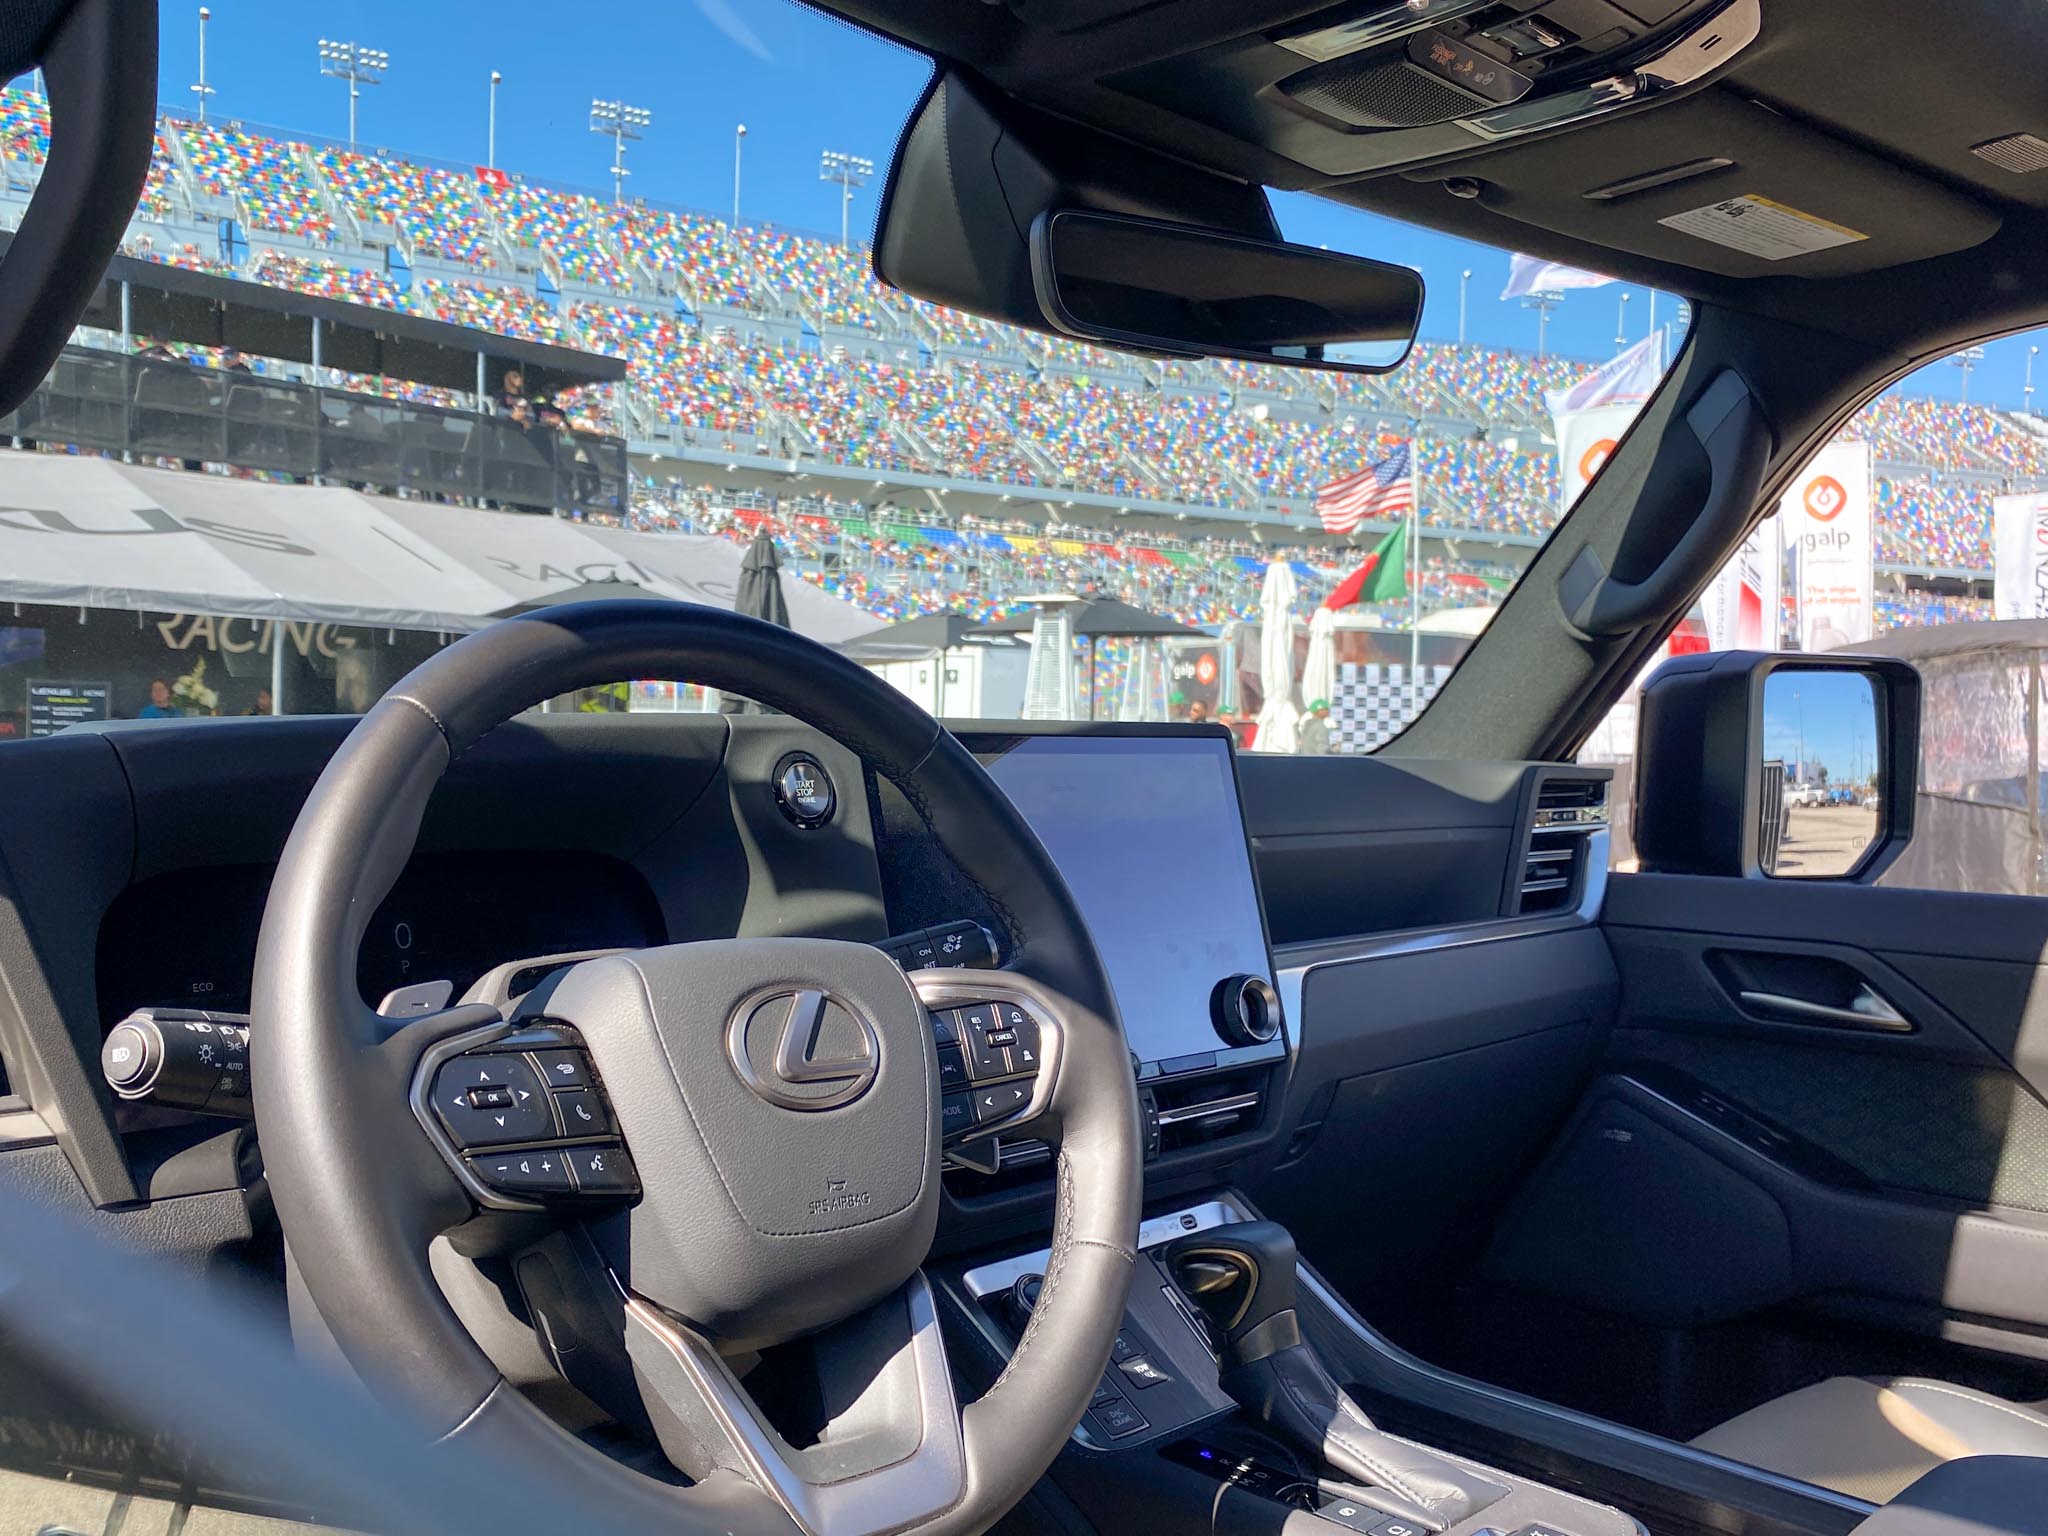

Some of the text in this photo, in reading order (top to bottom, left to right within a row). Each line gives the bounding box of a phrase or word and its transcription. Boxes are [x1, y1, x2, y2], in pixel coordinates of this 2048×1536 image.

[1805, 527, 1850, 552] galp
[157, 613, 356, 658] RACING
[1173, 662, 1195, 680] galp
[795, 780, 815, 789] START
[796, 788, 814, 797] STOP
[394, 922, 412, 949] 0
[919, 948, 932, 957] ON
[402, 959, 411, 974] P
[923, 960, 937, 969] INT
[192, 982, 214, 993] ECO
[970, 1016, 981, 1024] RES
[995, 1033, 1013, 1042] CANCEL
[226, 1062, 243, 1071] AUTO
[487, 1093, 499, 1102] OK
[831, 1191, 871, 1211] AIRBAG
[1134, 1363, 1150, 1374] TOW
